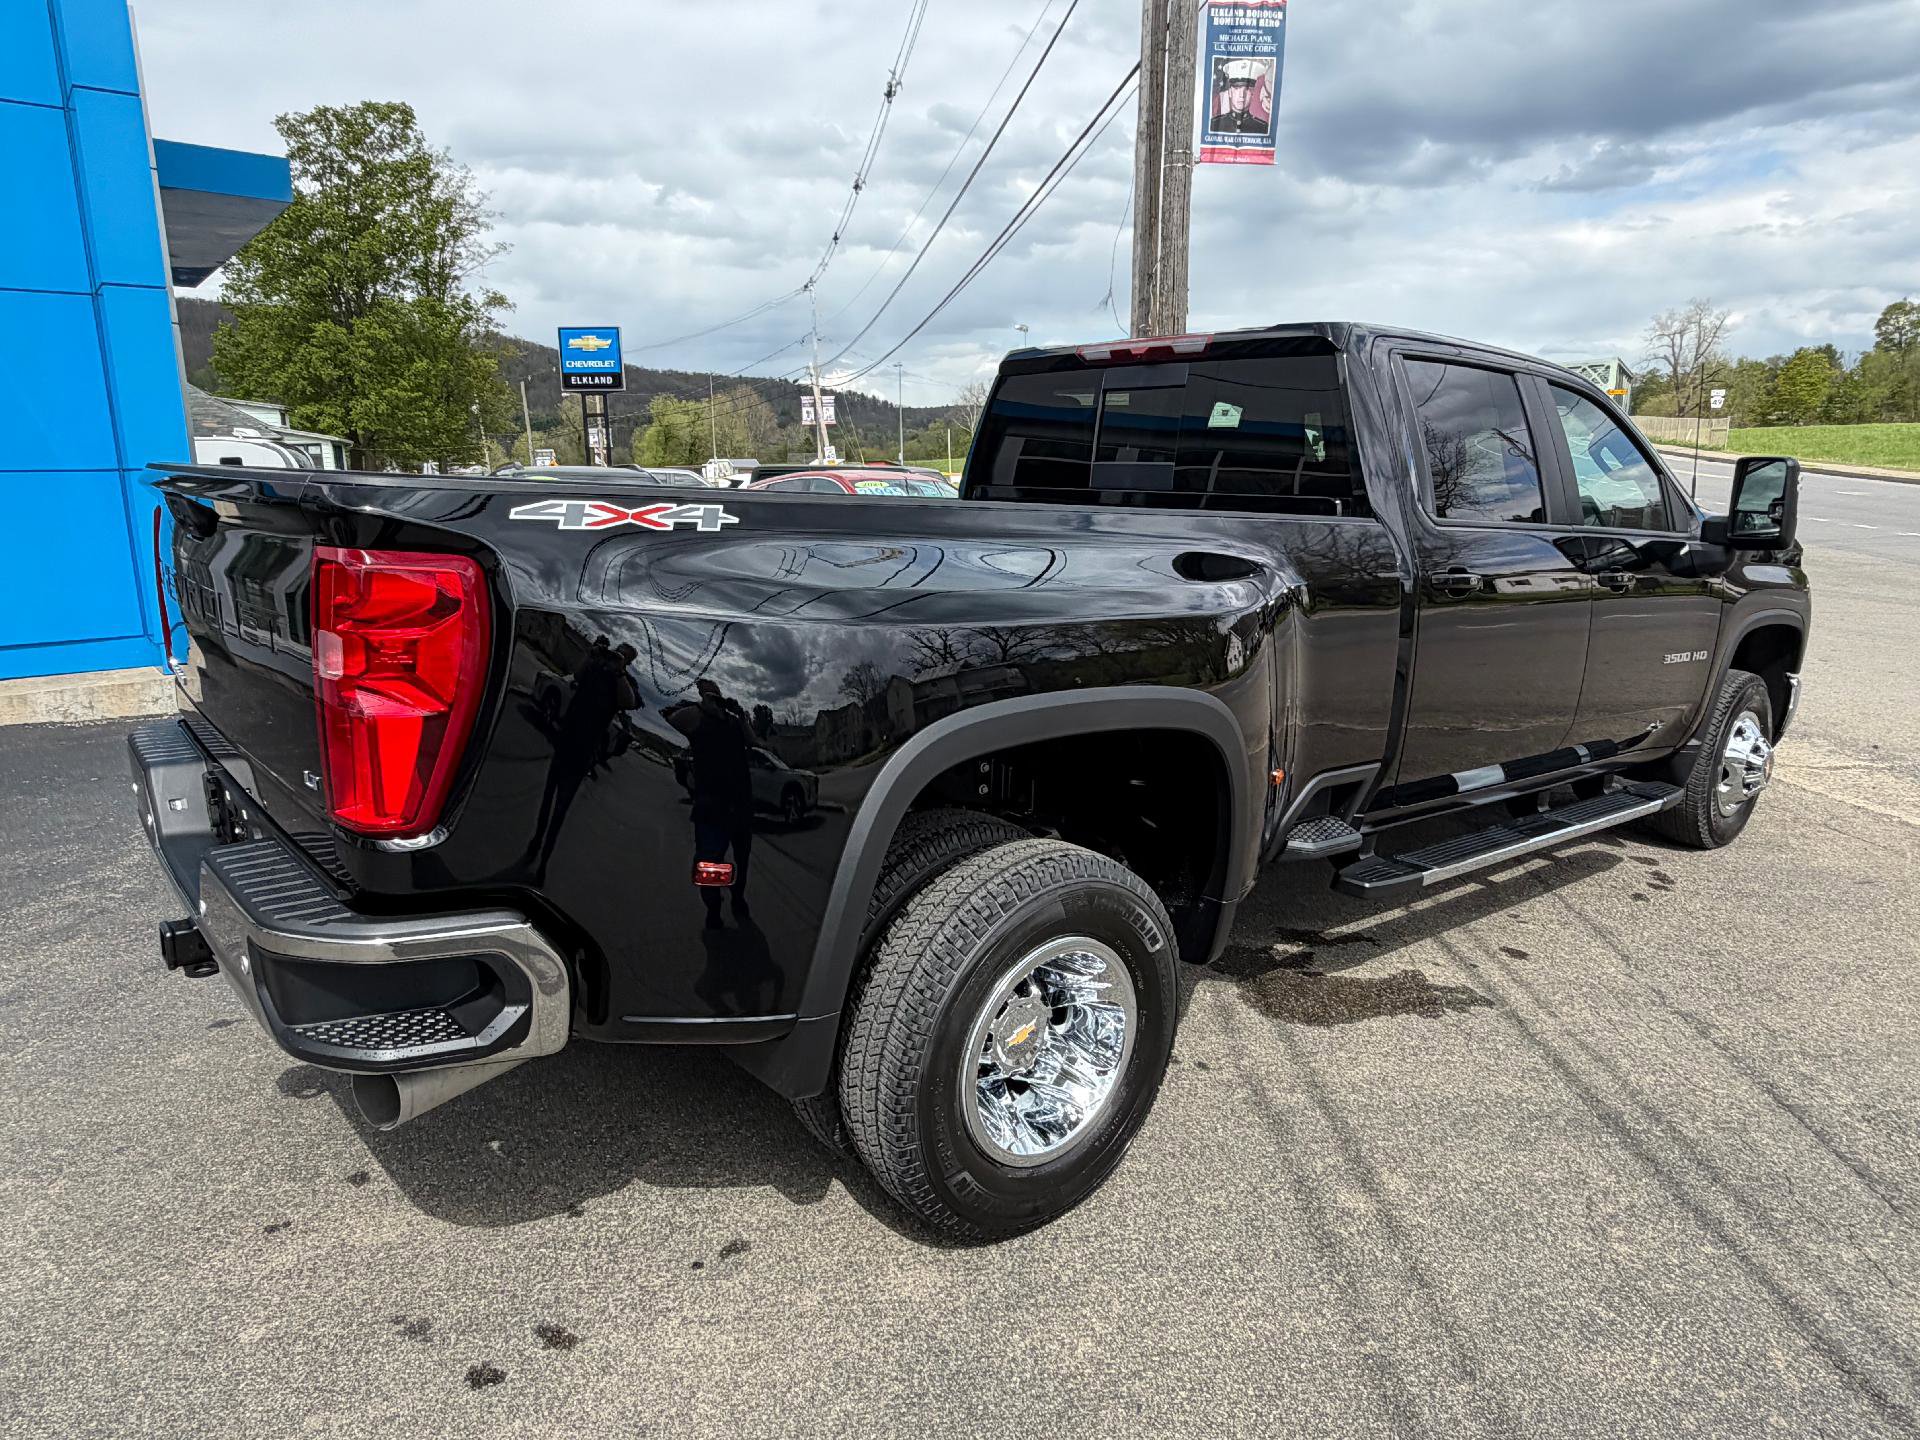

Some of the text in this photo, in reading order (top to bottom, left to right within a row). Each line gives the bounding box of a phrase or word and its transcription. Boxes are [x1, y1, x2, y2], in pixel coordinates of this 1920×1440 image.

[1246, 9, 1283, 20] BOROUGH
[1213, 17, 1280, 27] HOMETOWN HERO
[1219, 34, 1273, 43] MICHAEL PLANK
[1227, 44, 1253, 52] MARINE
[1254, 45, 1277, 53] CORPS
[565, 360, 616, 368] CHEVROLET
[571, 376, 613, 384] ELKLAND
[1663, 650, 1708, 664] 3500 HD
